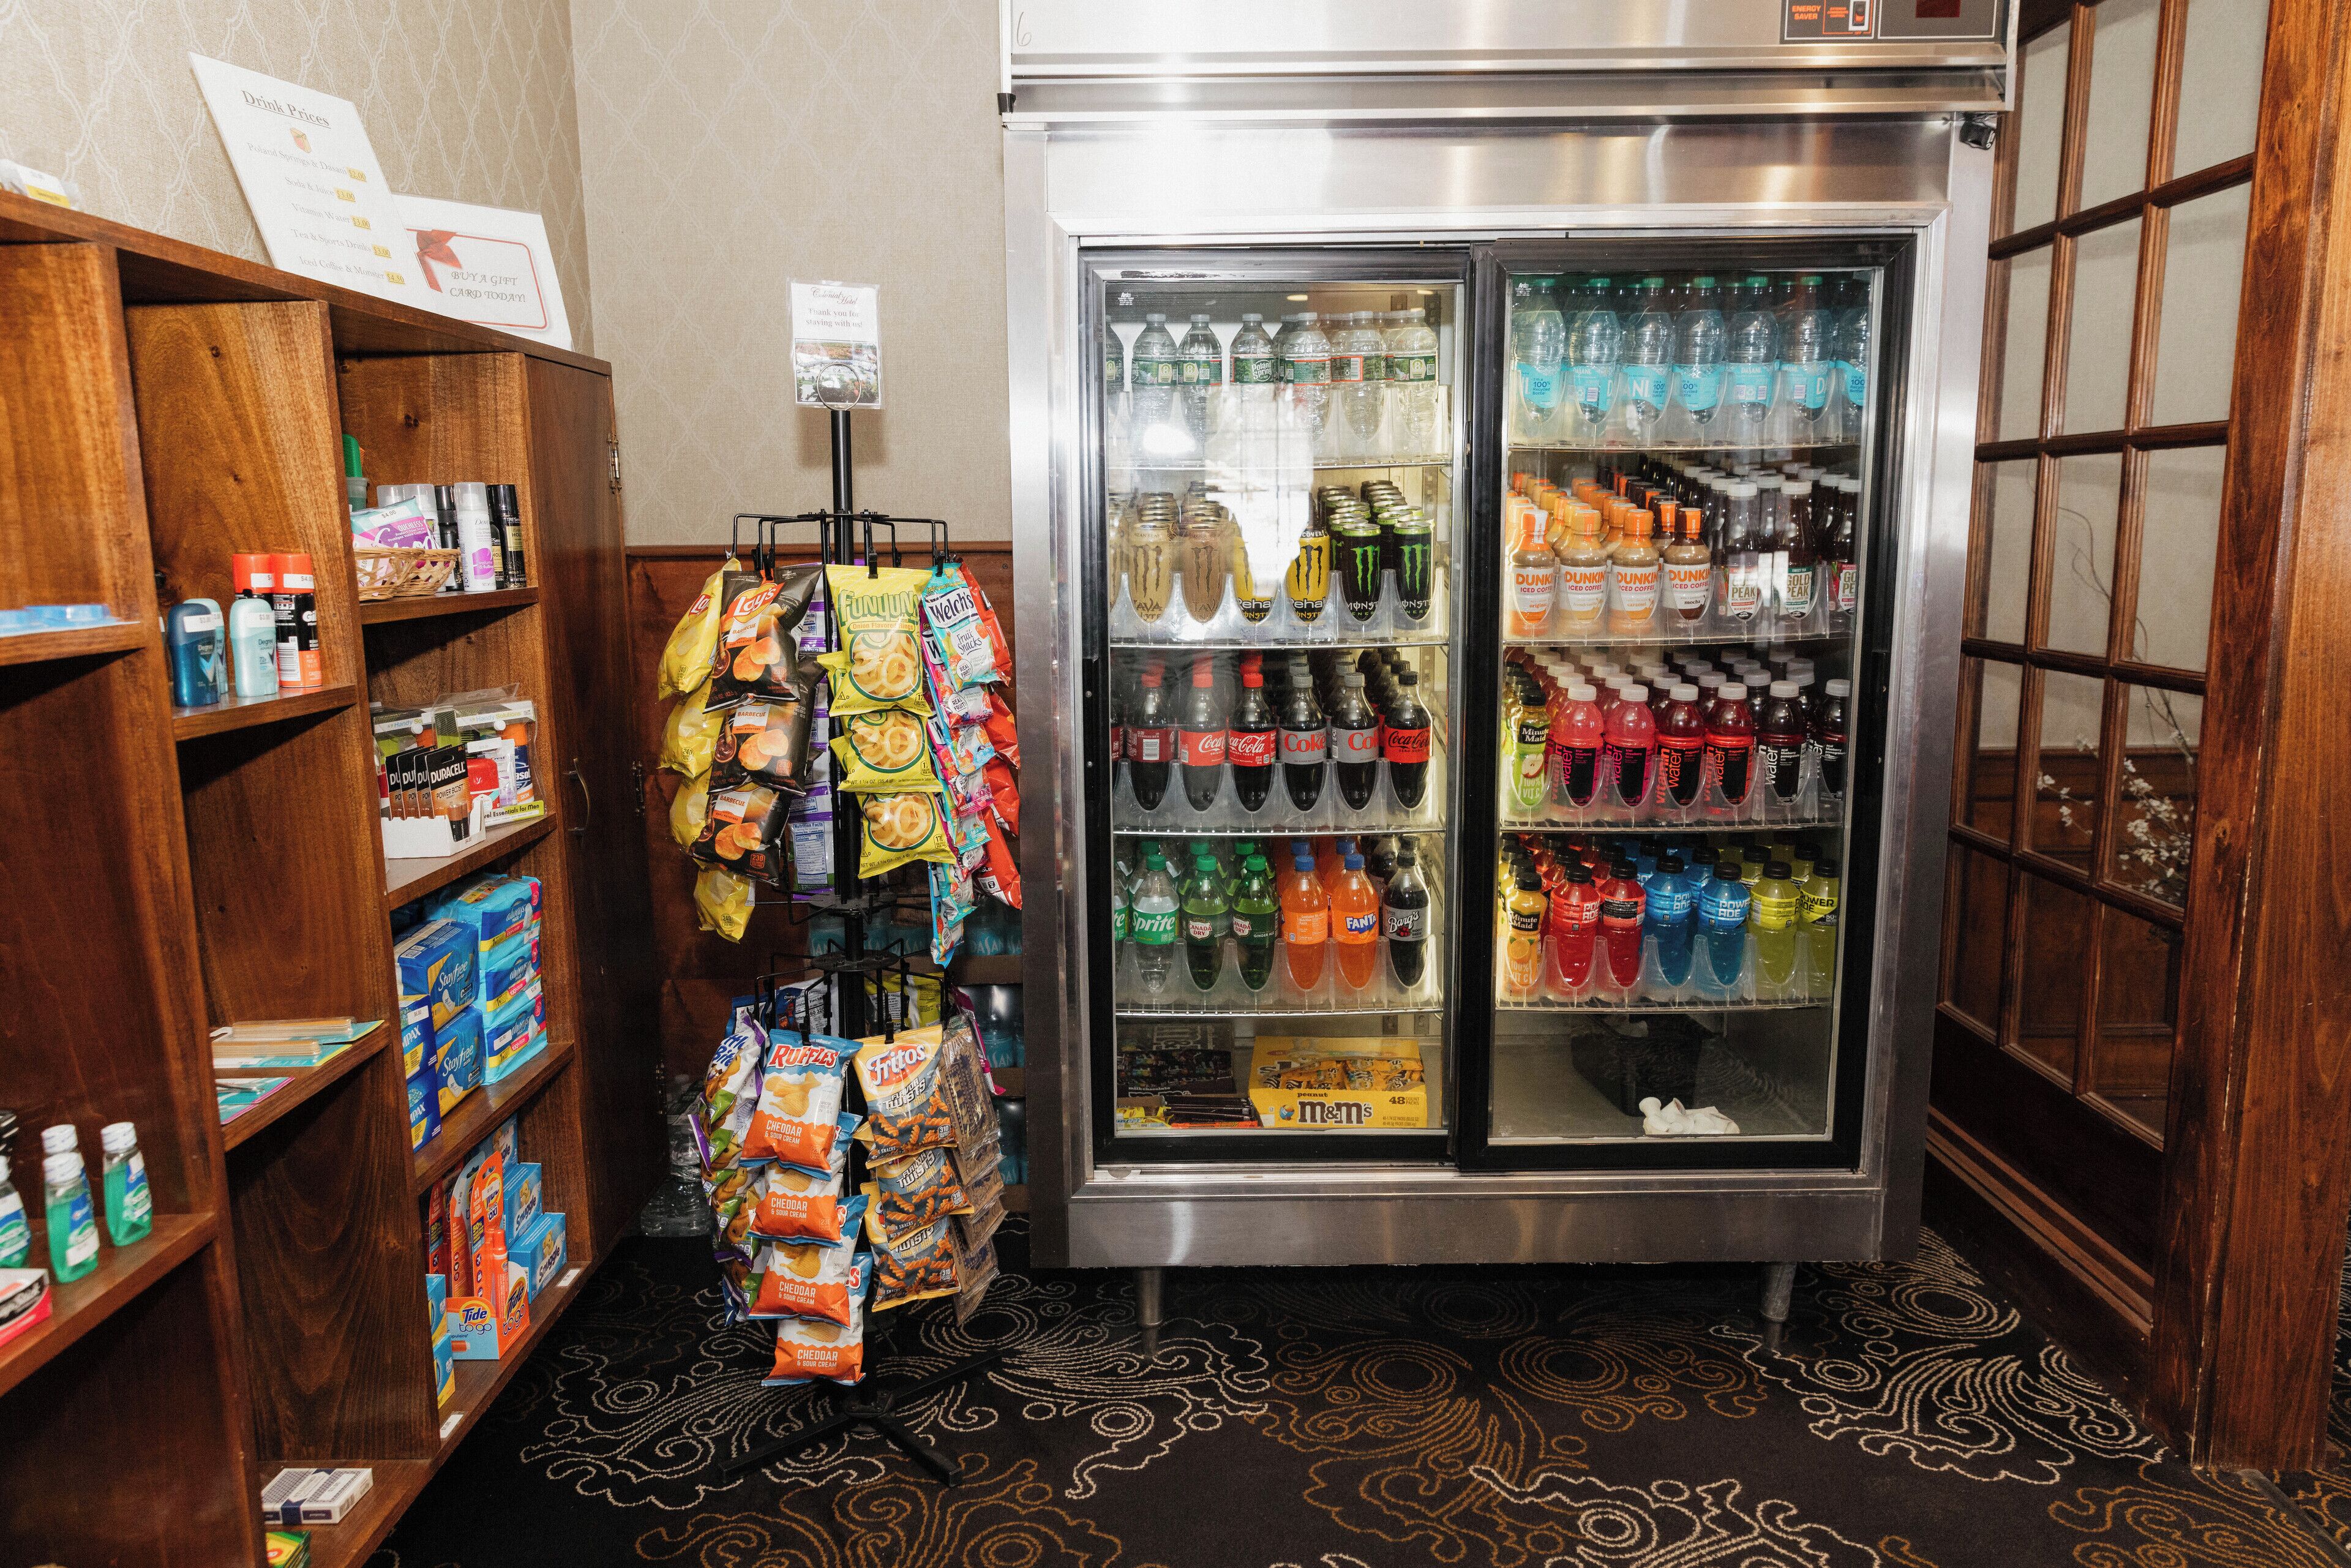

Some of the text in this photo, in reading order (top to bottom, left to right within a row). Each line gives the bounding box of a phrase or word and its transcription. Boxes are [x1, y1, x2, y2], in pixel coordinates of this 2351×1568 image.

[241, 89, 330, 126] Drink Prices
[247, 143, 277, 157] Poland
[279, 151, 310, 167] Springs
[320, 161, 347, 175] Dasani
[348, 168, 366, 181] $2.00
[285, 176, 306, 189] Soda
[315, 186, 334, 196] Juice
[336, 190, 356, 201] $3.00
[291, 203, 371, 229] Vitamin Water $3.00
[291, 228, 310, 239] Tea
[319, 234, 345, 246] Sports
[346, 240, 372, 252] Drinks
[373, 246, 391, 257] $3.00
[299, 257, 318, 268] Iced
[320, 260, 343, 272] Coffee
[354, 266, 385, 279] Monster
[386, 272, 405, 283] $4.50
[451, 271, 517, 286] BUY A GIFT
[450, 288, 525, 302] CARD TODAY!
[806, 319, 833, 328] staying
[381, 509, 397, 519] $4.00
[398, 520, 423, 531] OUCHLESS
[1787, 574, 1810, 586] GOLD
[1731, 587, 1756, 598] PEAK
[1787, 585, 1809, 598] PEAK
[733, 586, 777, 618] Lay's
[928, 590, 974, 623] Welch's
[732, 622, 757, 634] BARBECUE
[957, 629, 973, 642] Fruit
[958, 637, 983, 655] Snacks
[959, 664, 970, 672] REAL
[960, 668, 972, 678] FRUIT!
[951, 695, 963, 705] REAL
[953, 702, 966, 712] FRUIT!
[1284, 733, 1326, 752] Coke
[430, 762, 466, 784] DURACELL
[1669, 749, 1682, 788] water
[1715, 748, 1725, 786] water
[1765, 746, 1778, 785] water
[436, 787, 451, 799] POWER
[719, 795, 746, 807] BARBECUE
[493, 807, 519, 818] Essentials
[1800, 891, 1834, 907] POWER
[506, 903, 525, 922] always
[1133, 911, 1176, 932] Sprite
[1346, 912, 1377, 930] FANTA
[1388, 910, 1420, 933] Barq's
[1511, 913, 1537, 923] Minute
[1719, 909, 1741, 918] ADE
[1513, 921, 1533, 929] Maid
[438, 960, 468, 992] Stayfree
[511, 1016, 530, 1035] always
[443, 1045, 474, 1077] Stayfree
[768, 1045, 838, 1068] RUFFLES
[866, 1043, 927, 1086] Fritos
[882, 1078, 926, 1110] TWISTS
[891, 1078, 919, 1100] FLAVOR
[1298, 1100, 1373, 1125] m&m's
[766, 1119, 803, 1138] CHEDDAR
[783, 1136, 800, 1144] CREAM
[896, 1149, 936, 1188] TWISTS
[516, 1195, 536, 1231] Snuggle
[771, 1197, 808, 1212] CHEDDAR
[899, 1221, 913, 1230] SNACKS
[901, 1247, 919, 1258] HONEY
[539, 1247, 560, 1283] Snuggle
[779, 1281, 816, 1298] CHEDDAR
[507, 1284, 525, 1319] Tide
[783, 1293, 796, 1302] SOUR
[797, 1296, 815, 1305] CREAM
[462, 1307, 488, 1324] Tide
[459, 1323, 492, 1335] to go
[797, 1349, 838, 1361] CHEDDAR
